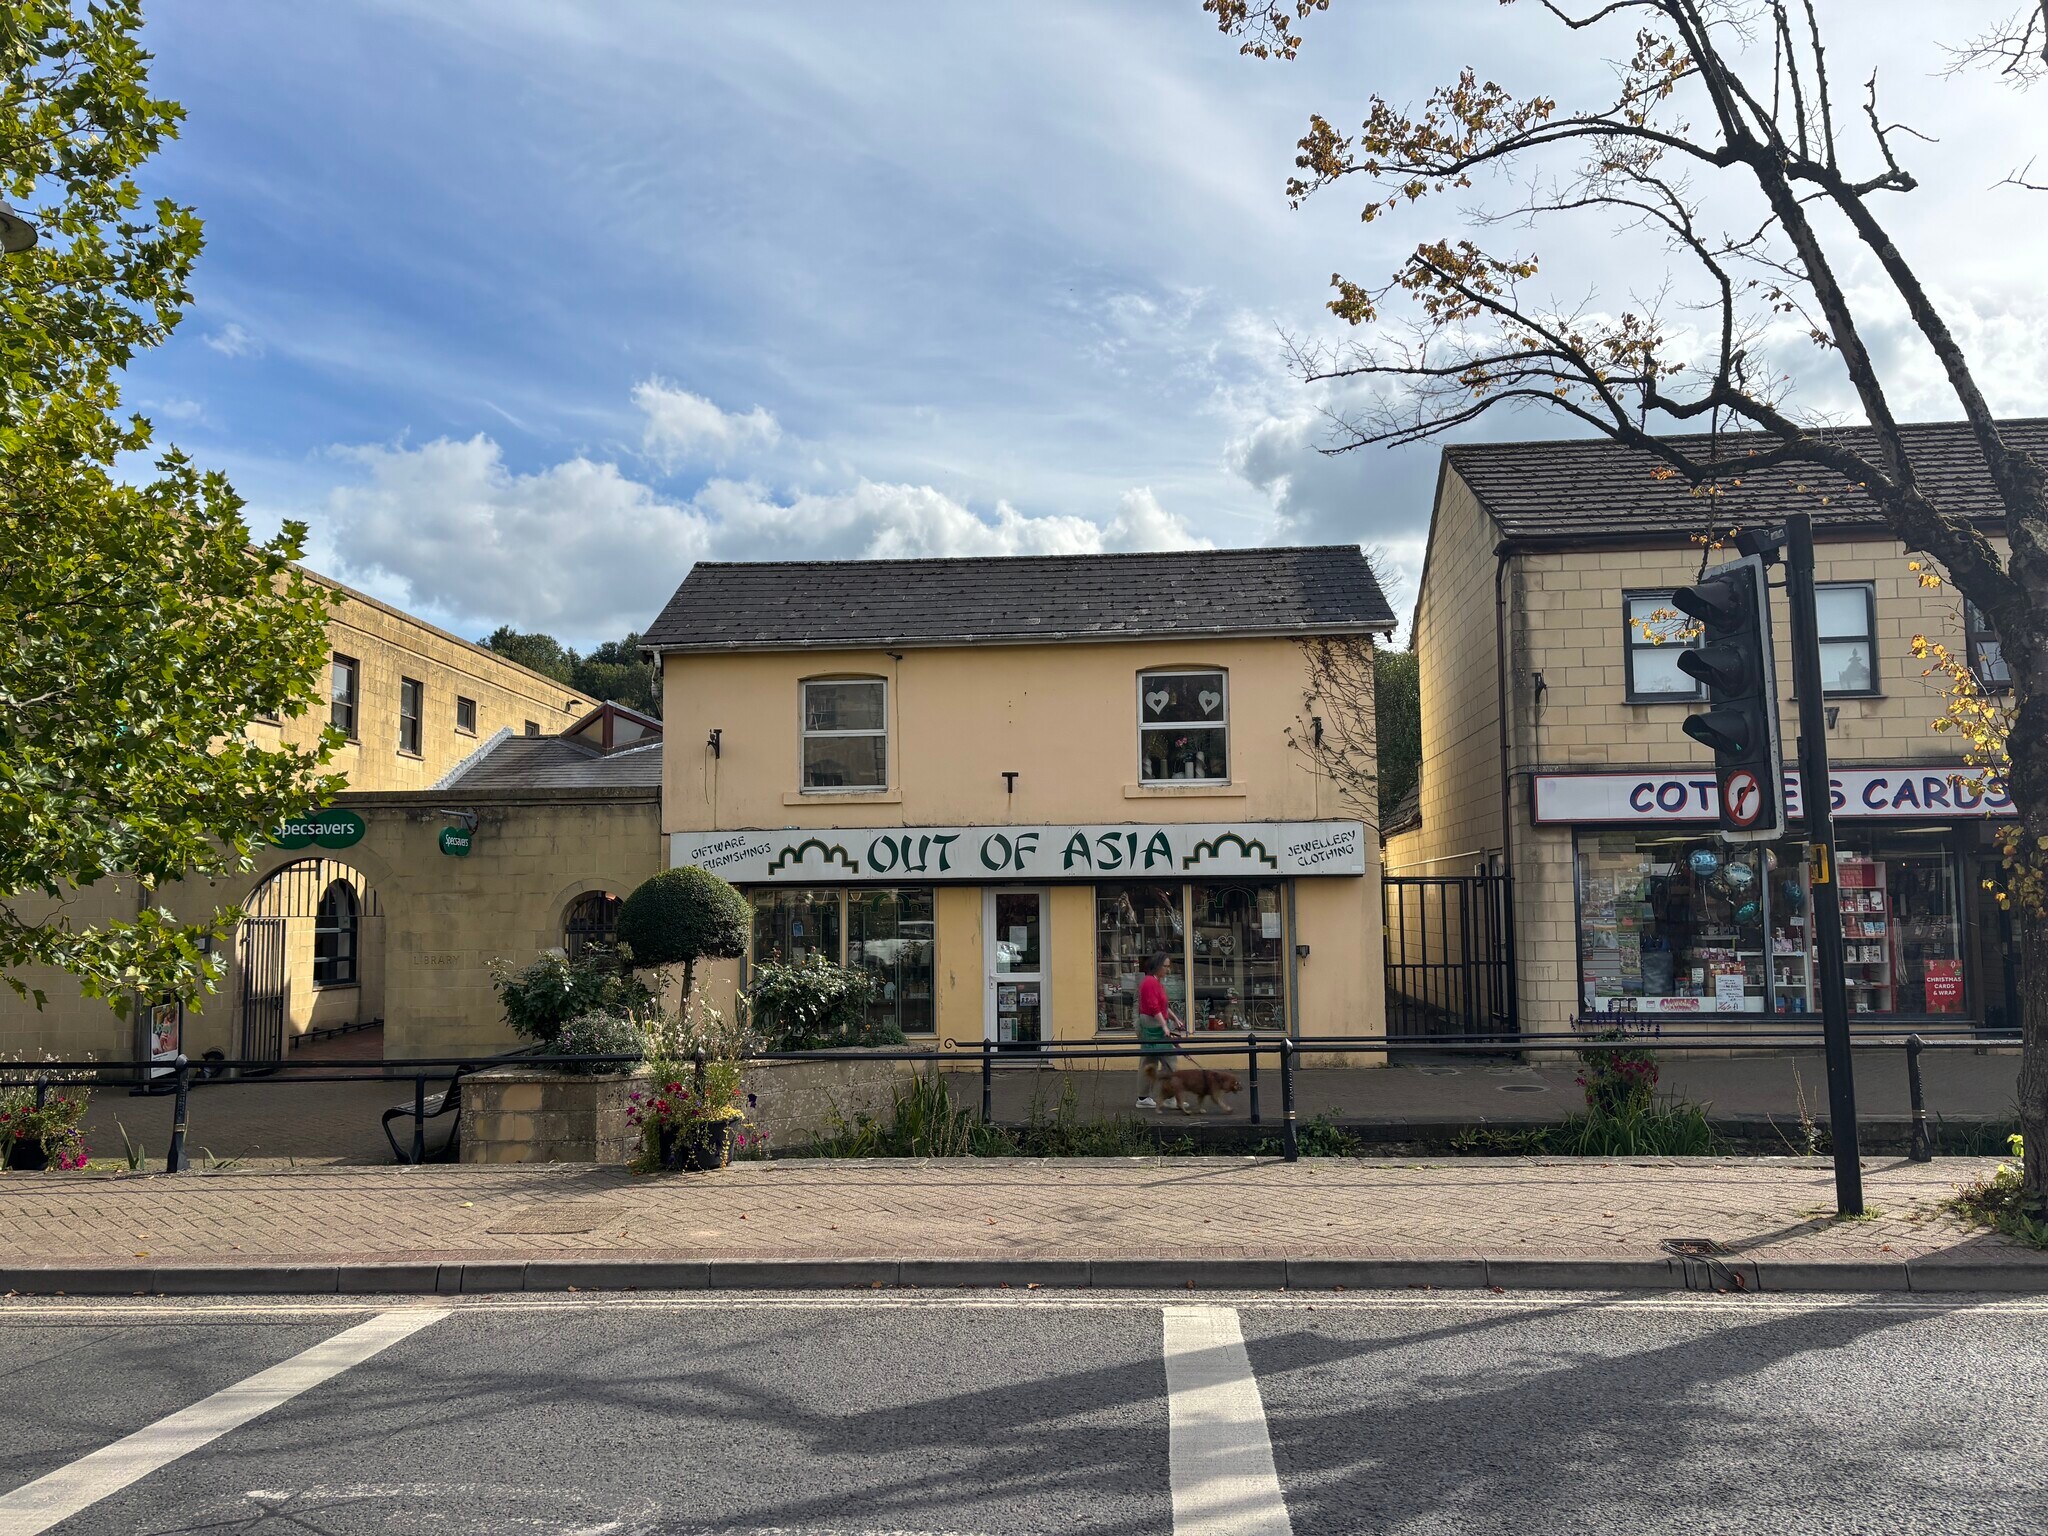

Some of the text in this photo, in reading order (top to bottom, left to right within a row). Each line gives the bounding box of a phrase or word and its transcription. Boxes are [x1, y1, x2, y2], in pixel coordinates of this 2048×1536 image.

[1629, 776, 2014, 813] COTES CARDS
[272, 822, 355, 839] Specsavers
[445, 834, 469, 847] Specsavers
[1288, 829, 1356, 857] JEWELLERY
[691, 835, 746, 860] GIFTWARE
[702, 843, 772, 870] FURNISHINGS
[867, 828, 1174, 873] OUT OF ASIA
[1297, 844, 1355, 867] CLOTHING
